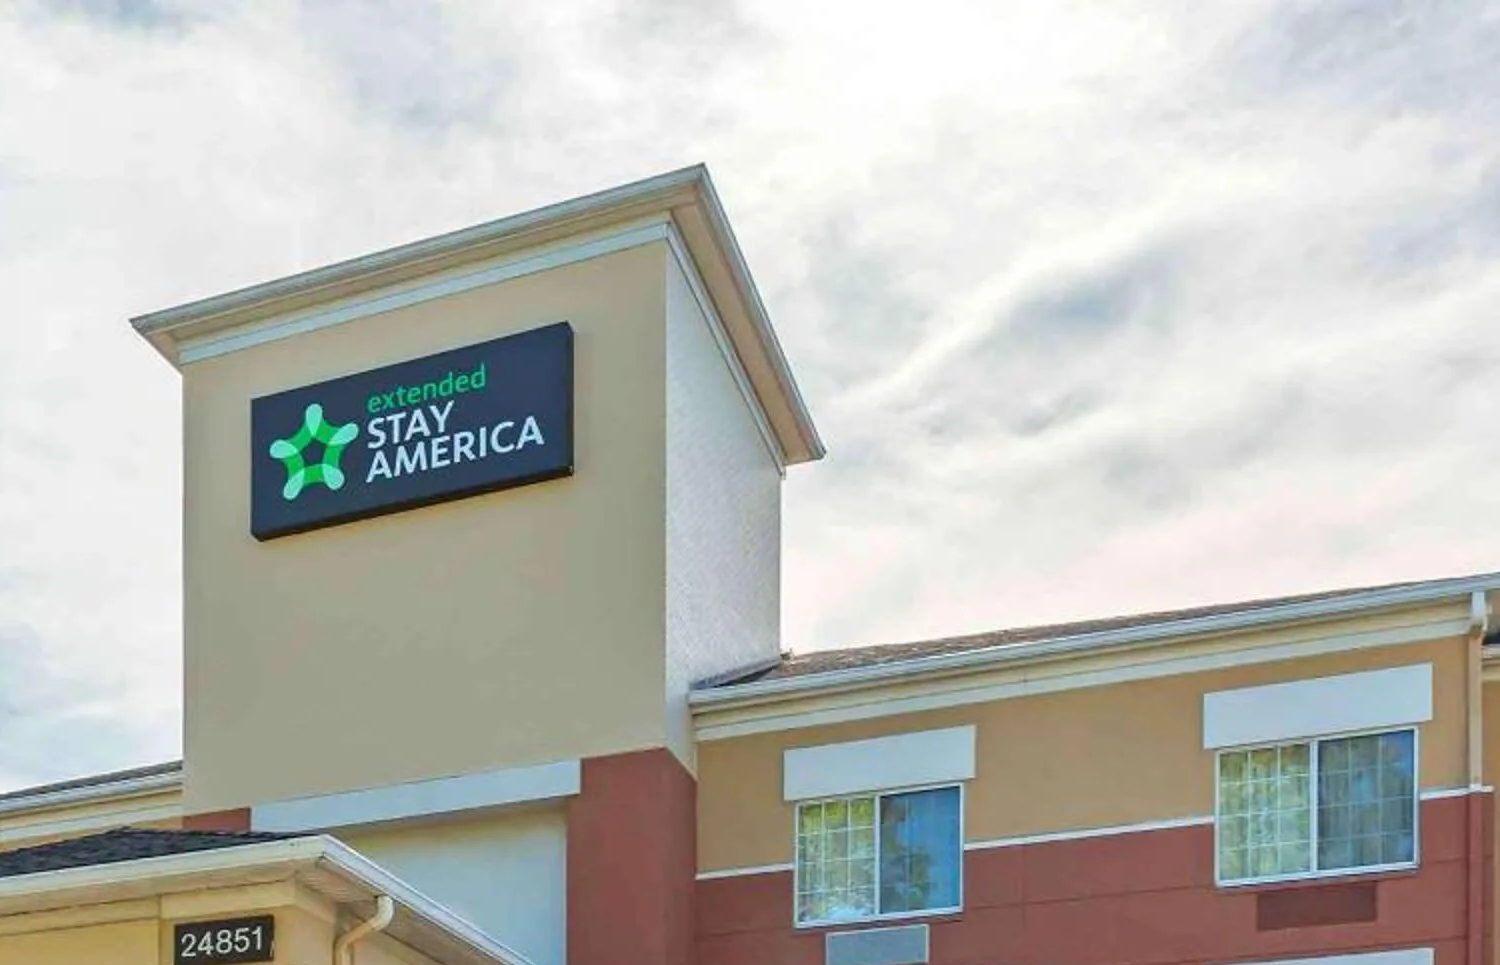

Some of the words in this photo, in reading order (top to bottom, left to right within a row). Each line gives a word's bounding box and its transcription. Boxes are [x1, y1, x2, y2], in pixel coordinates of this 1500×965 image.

[367, 361, 486, 414] extended
[366, 415, 545, 483] AMERICA
[367, 400, 455, 449] STAY
[180, 925, 263, 958] 24851
